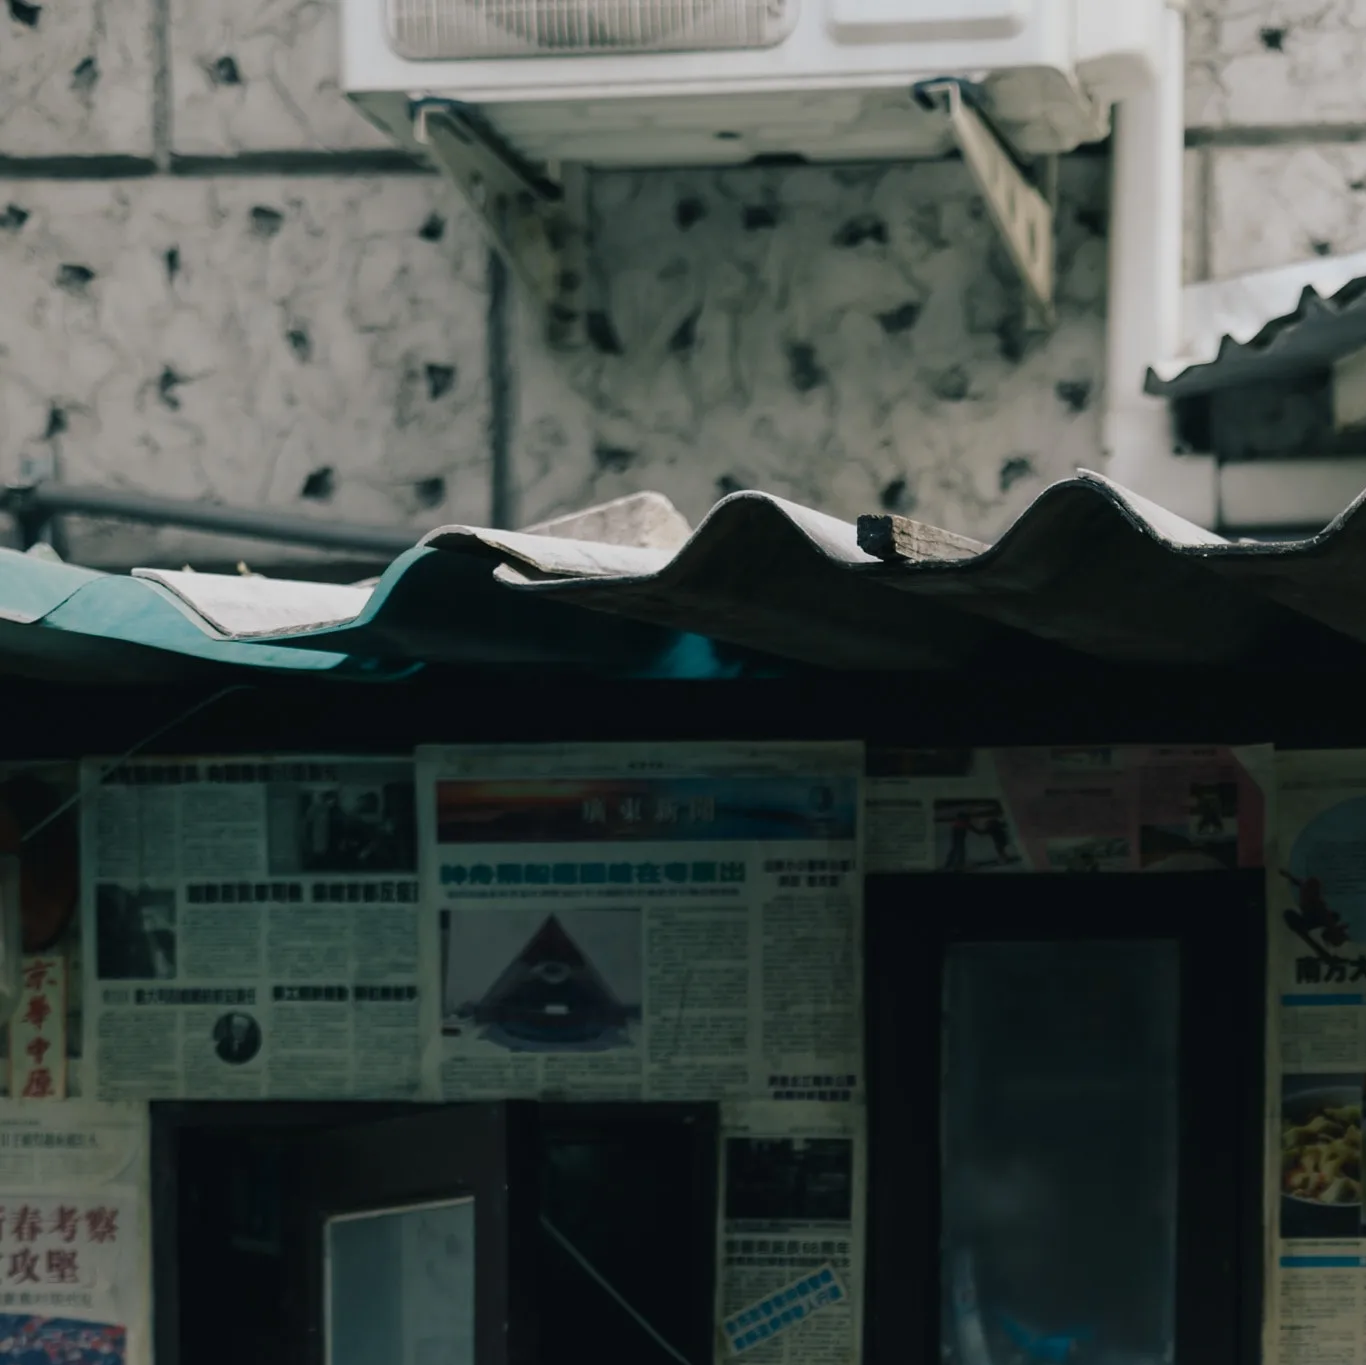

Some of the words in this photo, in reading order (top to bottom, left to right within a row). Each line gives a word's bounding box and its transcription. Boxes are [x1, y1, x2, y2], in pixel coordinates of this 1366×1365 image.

[0, 1203, 119, 1243] 春考察
[0, 1248, 79, 1284] 攻堅
